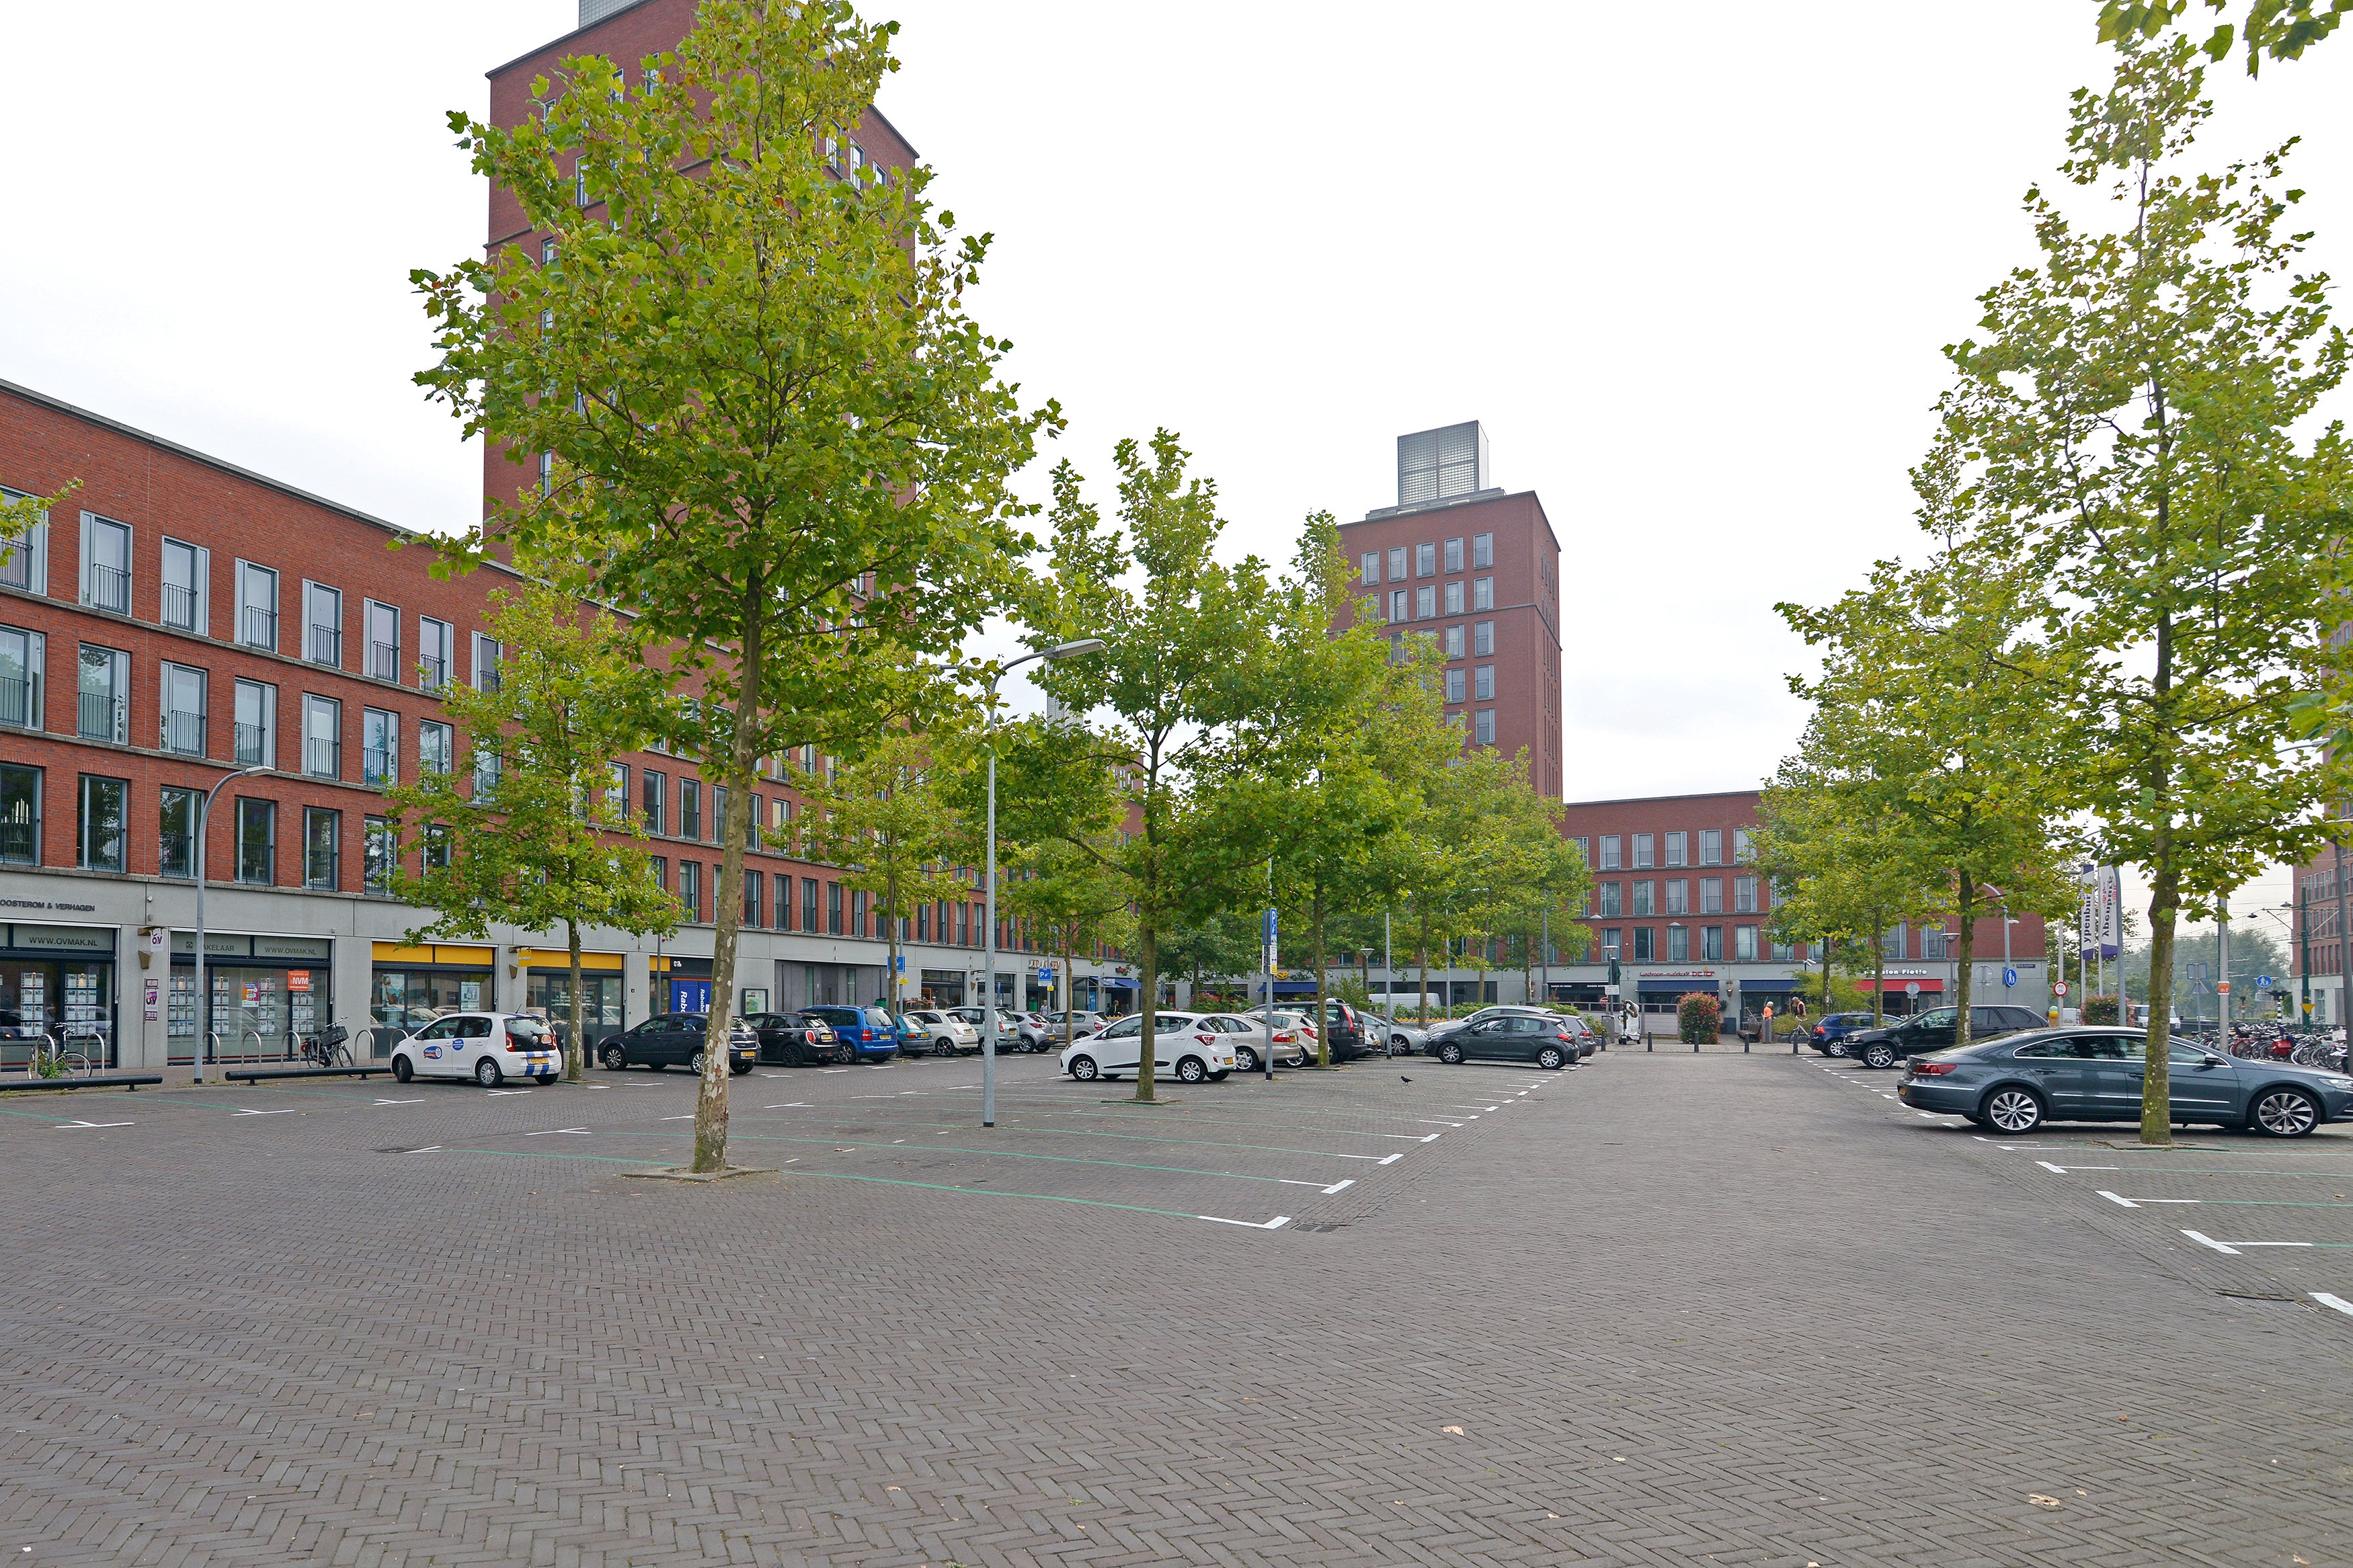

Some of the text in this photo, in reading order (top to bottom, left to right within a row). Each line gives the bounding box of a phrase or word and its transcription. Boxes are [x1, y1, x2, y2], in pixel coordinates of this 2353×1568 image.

[0, 899, 44, 908] OOSTEROM
[56, 903, 95, 911] VERHAGEN
[29, 937, 98, 946] WWW.OVMAK.NL
[265, 947, 317, 955] WWW.OVMAK.NL
